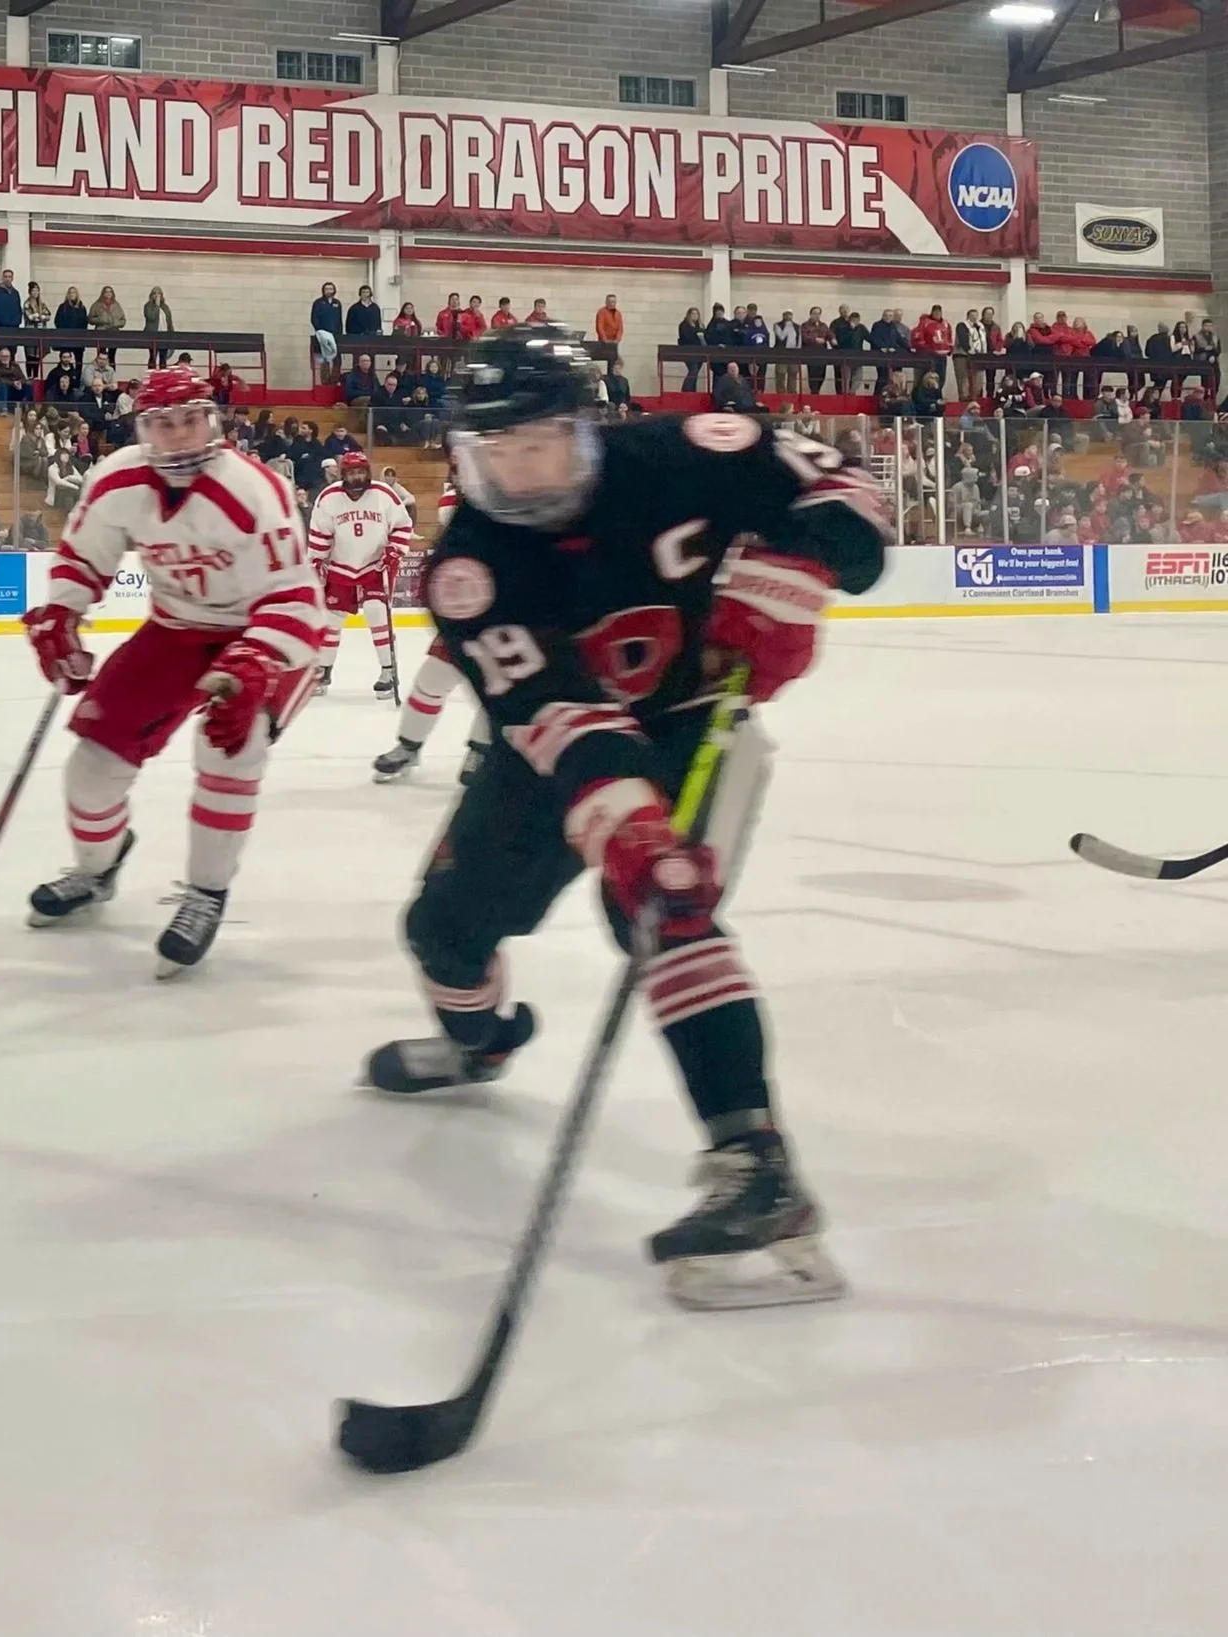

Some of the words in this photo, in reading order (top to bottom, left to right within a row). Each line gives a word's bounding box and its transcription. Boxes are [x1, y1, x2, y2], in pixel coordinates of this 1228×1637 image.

[241, 105, 378, 204] RED
[401, 114, 676, 219] DRAGON
[702, 132, 882, 228] PRIDE
[957, 184, 1013, 209] NCAA
[1087, 224, 1152, 246] SUNYAC
[354, 522, 363, 537] 8
[261, 527, 303, 572] 17
[652, 517, 711, 581] C
[1027, 549, 1044, 557] your
[1146, 553, 1210, 574] ESPN
[1210, 569, 1228, 585] 10
[968, 590, 1011, 598] Convenient
[1012, 589, 1044, 597] Cortland
[1045, 589, 1079, 597] Branches
[462, 623, 548, 697] 19
